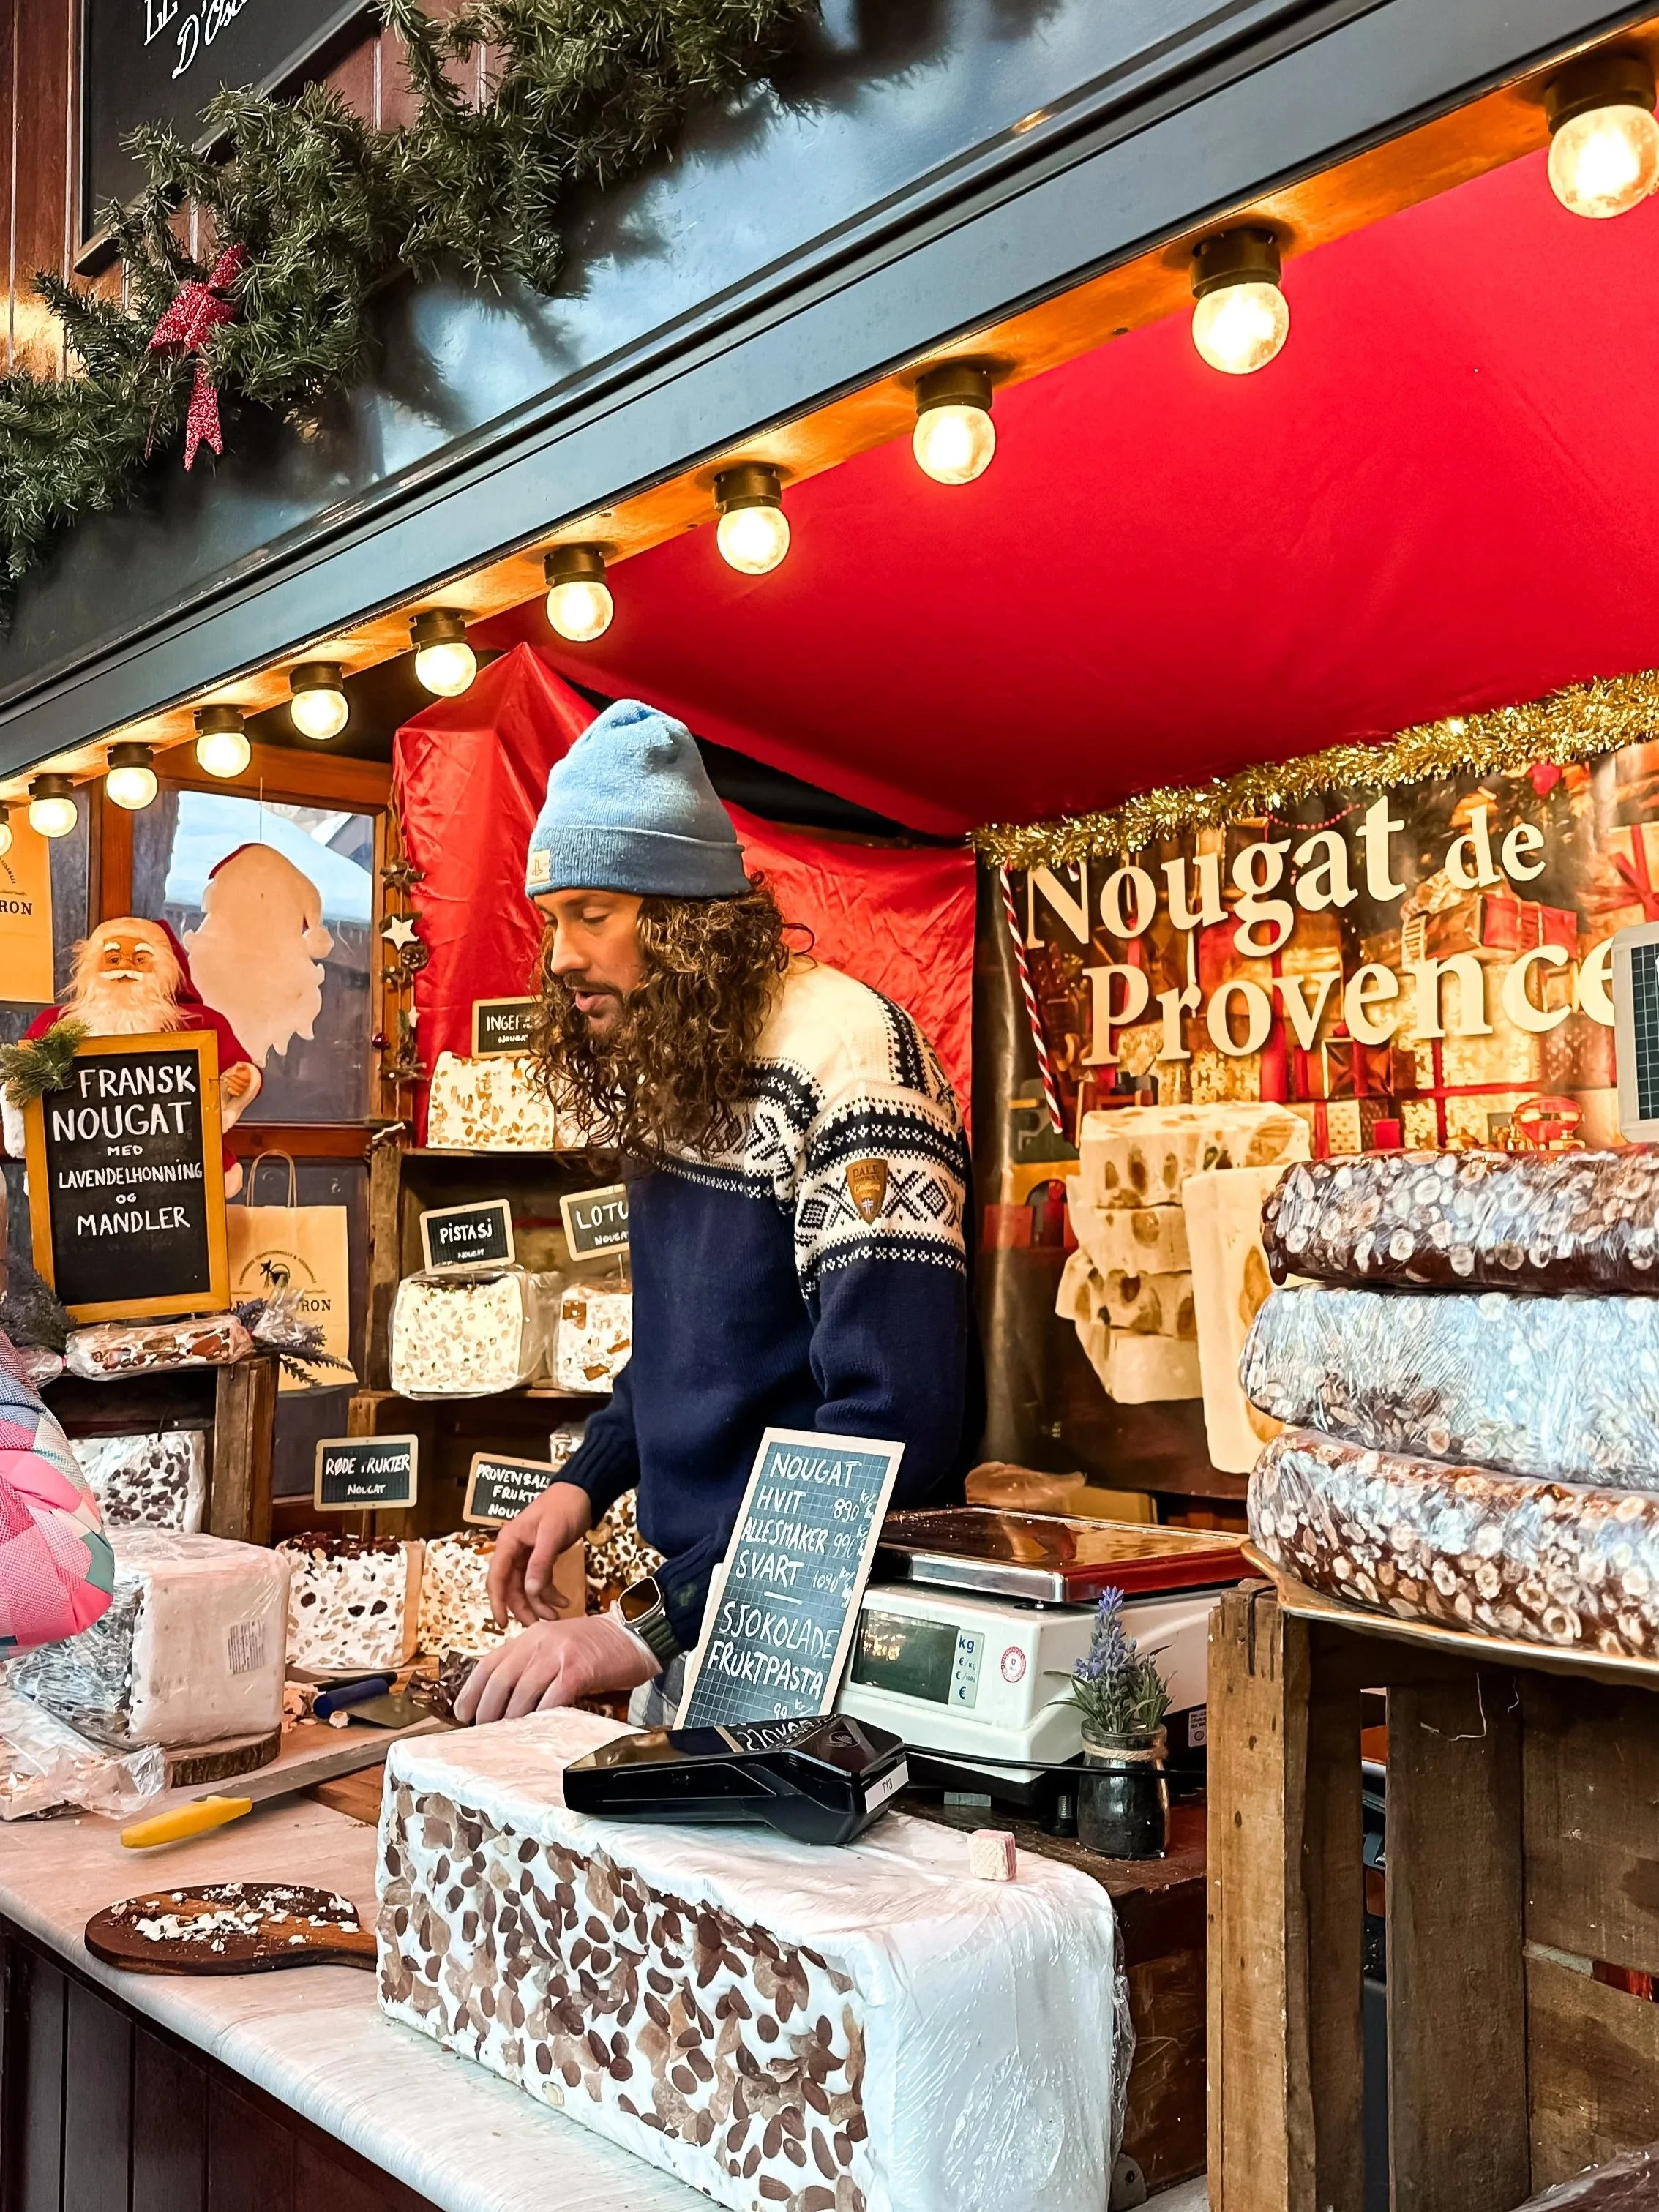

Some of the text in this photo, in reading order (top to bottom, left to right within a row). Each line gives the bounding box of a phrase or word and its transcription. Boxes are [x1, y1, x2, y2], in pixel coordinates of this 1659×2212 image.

[1025, 796, 1546, 957] Nougat de
[79, 1065, 196, 1098] FRANSK
[53, 1102, 192, 1141] NOUGAT
[107, 1144, 143, 1156] MED
[116, 1193, 138, 1204] OG
[77, 1206, 190, 1236] MANDLER
[594, 1231, 629, 1245] NOUGA
[326, 1457, 356, 1475] RØDE
[770, 1452, 863, 1488] NOUGAT
[757, 1485, 806, 1515] HVIT
[833, 1498, 860, 1523] 890
[735, 1549, 804, 1587] SVART
[812, 1570, 839, 1594] 1090
[719, 1600, 839, 1660] SJOKOLADE
[959, 1634, 975, 1654] kg
[707, 1640, 824, 1701] FRUKTPASTA
[959, 1686, 967, 1700] €
[881, 1777, 893, 1793] TY3
